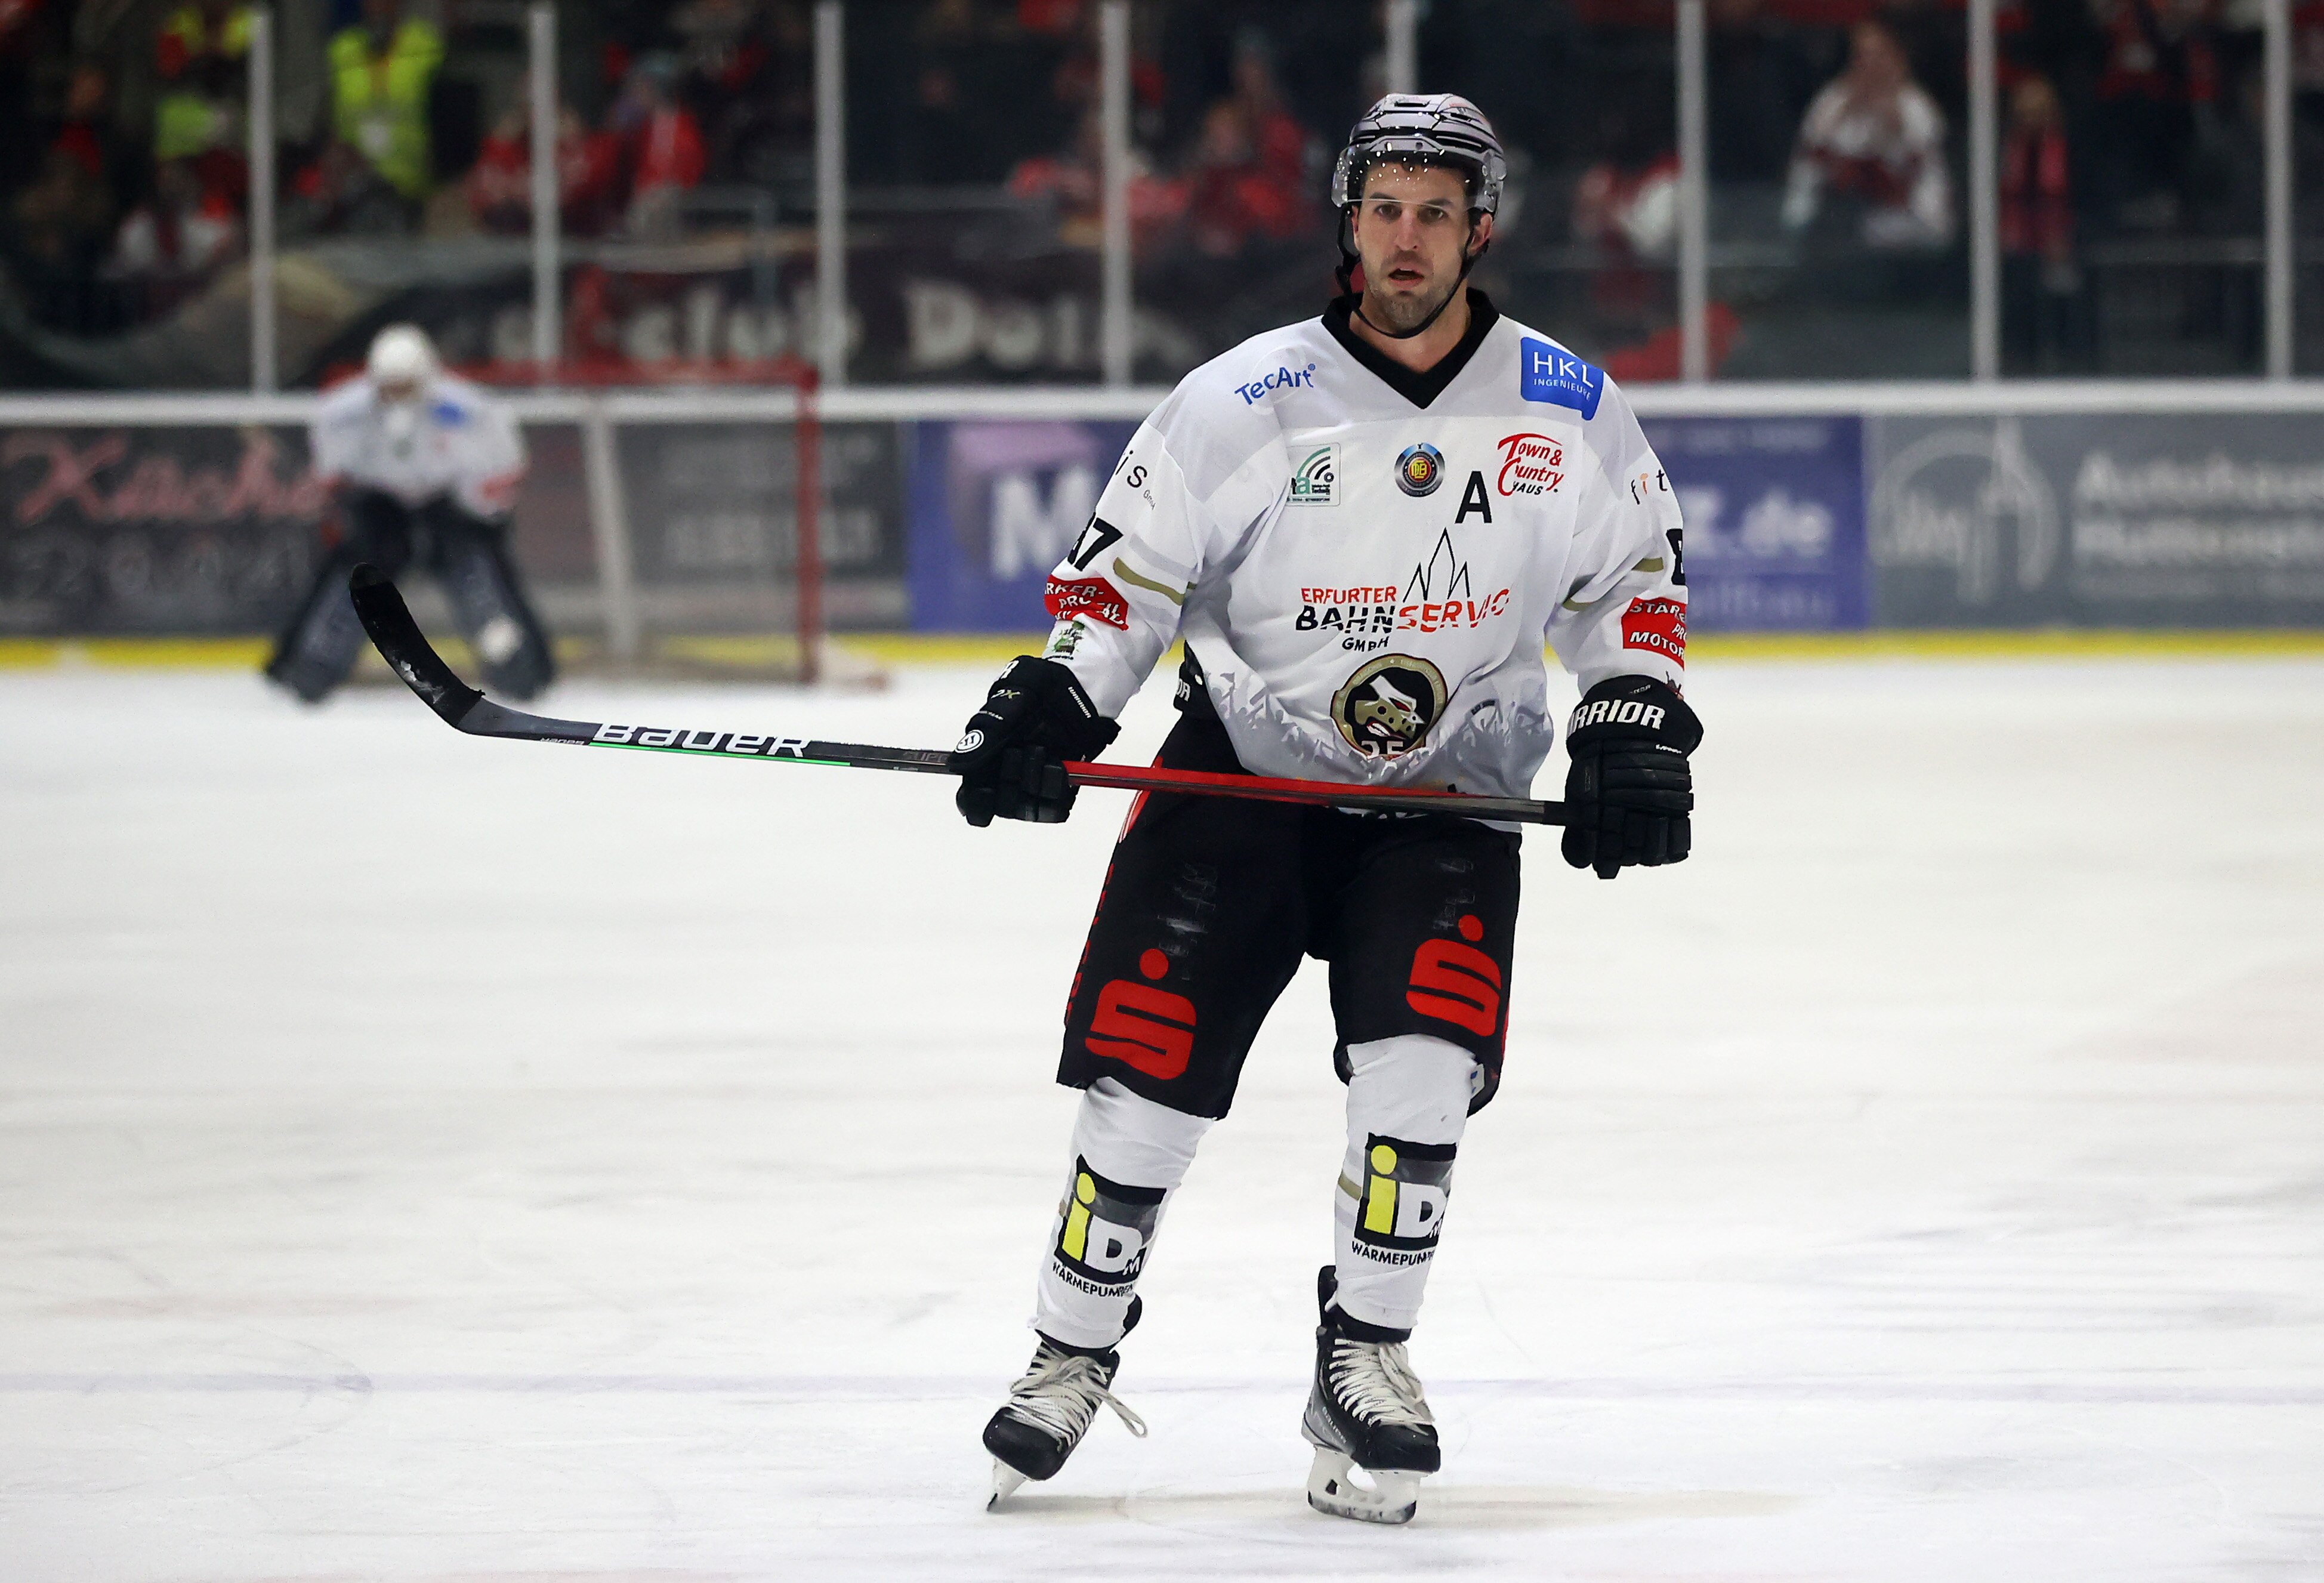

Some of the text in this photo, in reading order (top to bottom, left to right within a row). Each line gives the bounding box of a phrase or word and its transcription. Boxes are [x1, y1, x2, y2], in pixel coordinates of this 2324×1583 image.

[1533, 351, 1594, 388] HKL
[1533, 378, 1592, 402] INGENIEURE
[1498, 433, 1563, 467] Town &
[1455, 470, 1492, 524] A
[1631, 468, 1668, 505] fit
[1044, 582, 1104, 597] RKER-
[1301, 585, 1397, 604] ERFURTER
[1629, 631, 1685, 661] MOTOR
